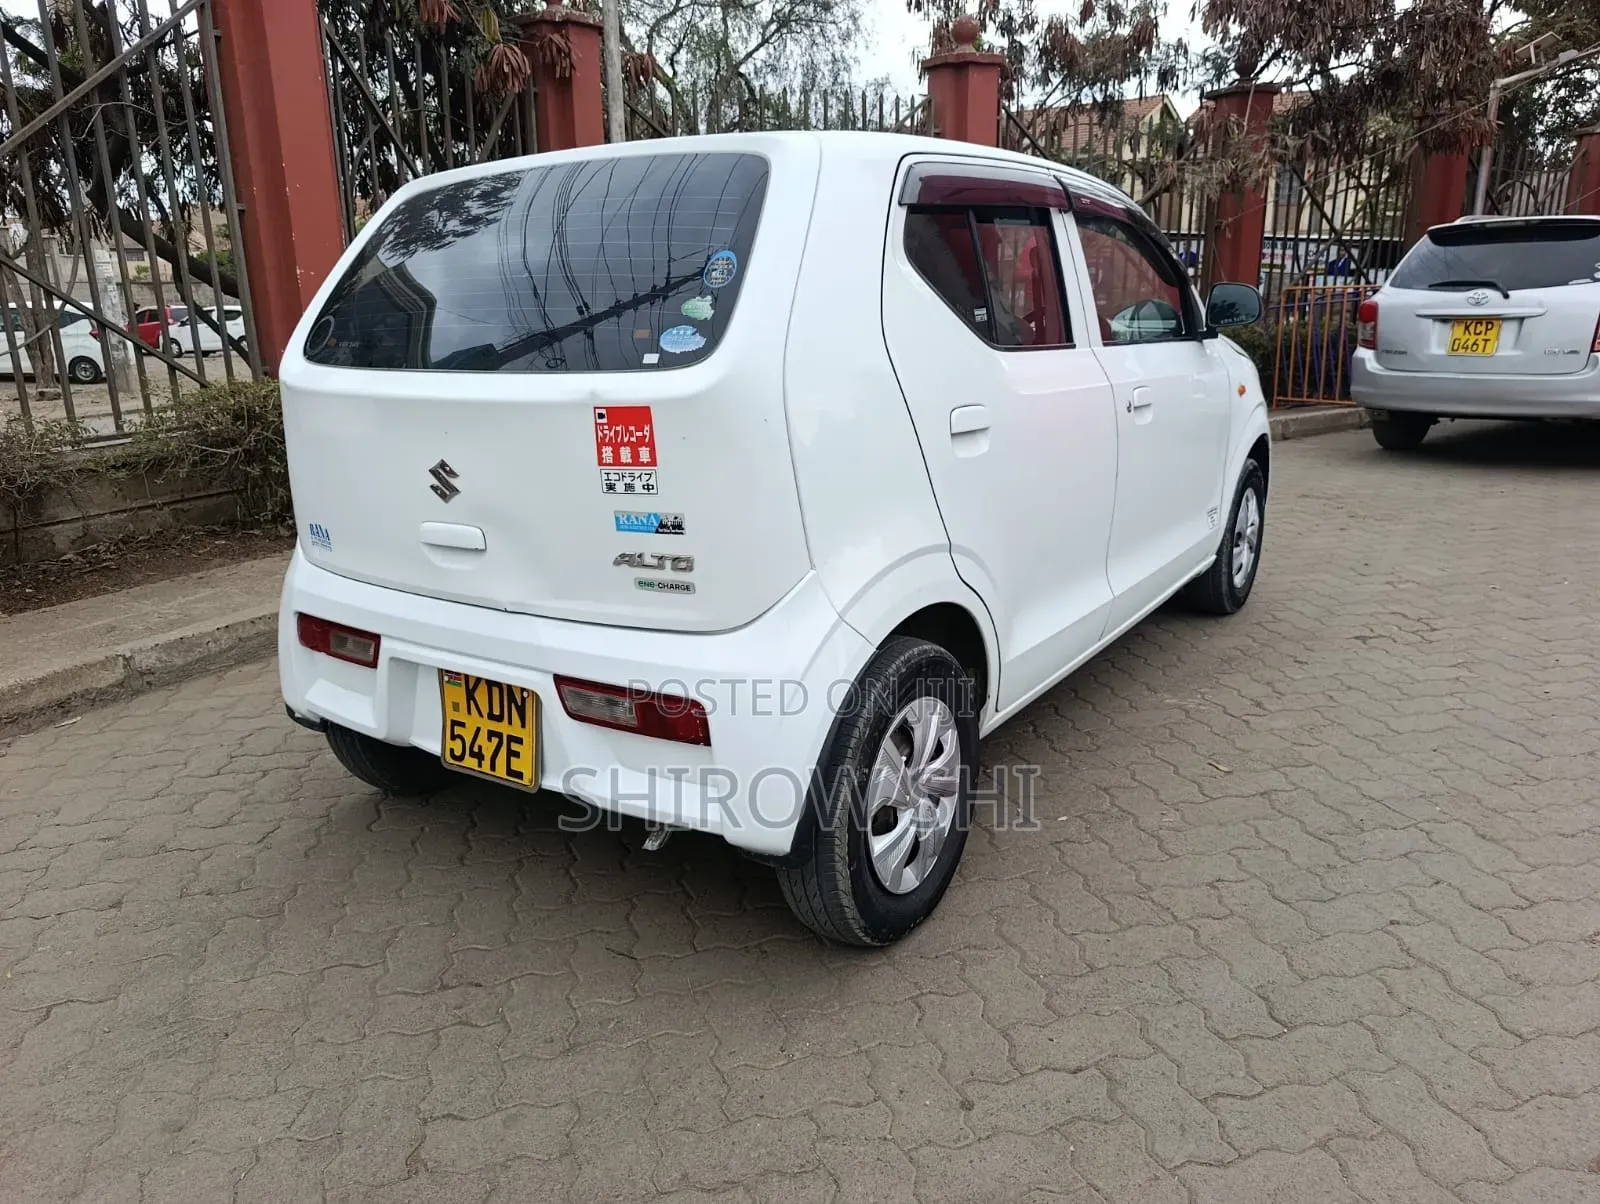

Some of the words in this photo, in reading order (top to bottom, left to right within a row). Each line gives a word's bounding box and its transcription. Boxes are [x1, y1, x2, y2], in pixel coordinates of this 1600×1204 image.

[1463, 320, 1494, 336] KCP
[1451, 337, 1491, 353] 046T
[597, 424, 650, 443] ドライブレコーダ
[604, 472, 653, 482] エコドライブ
[613, 552, 695, 573] ALTO
[463, 673, 527, 729] KDN
[449, 718, 524, 781] 547E
